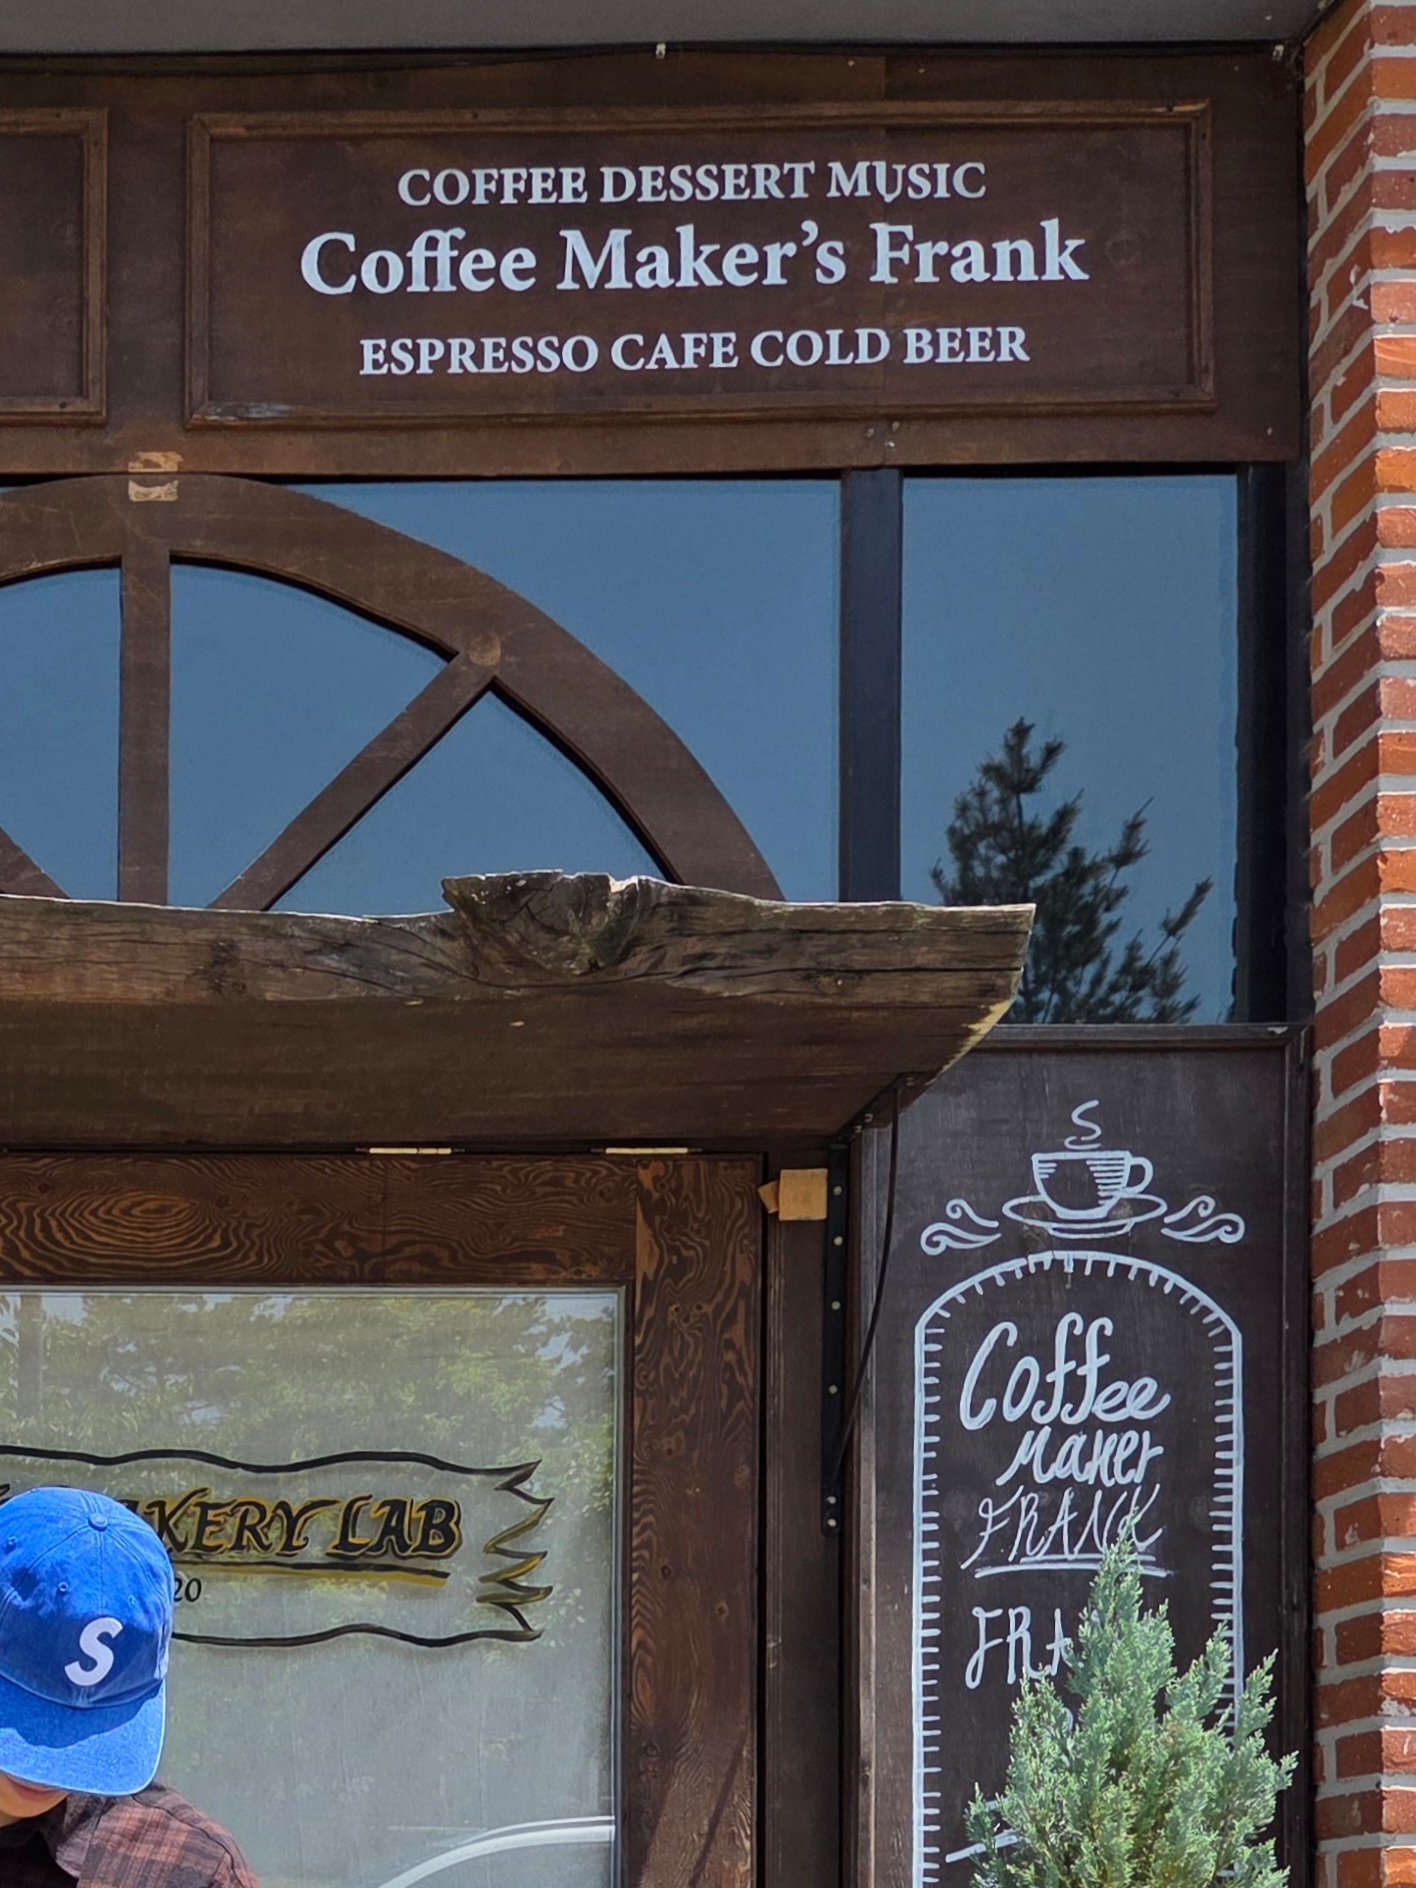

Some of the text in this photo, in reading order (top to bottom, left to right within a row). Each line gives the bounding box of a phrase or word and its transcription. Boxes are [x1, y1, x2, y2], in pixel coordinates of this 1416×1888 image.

[398, 160, 986, 206] COFFEE DESSERT MUSIC
[301, 227, 537, 295] Coffee
[869, 217, 1090, 285] Frank
[359, 326, 1031, 375] ESPRESSO CAFE COLD BEER
[958, 1311, 1172, 1431] Coffee
[144, 1487, 341, 1558] KERY
[325, 1493, 464, 1560] LAB
[960, 1482, 1164, 1570] FRANK
[64, 1616, 124, 1688] S
